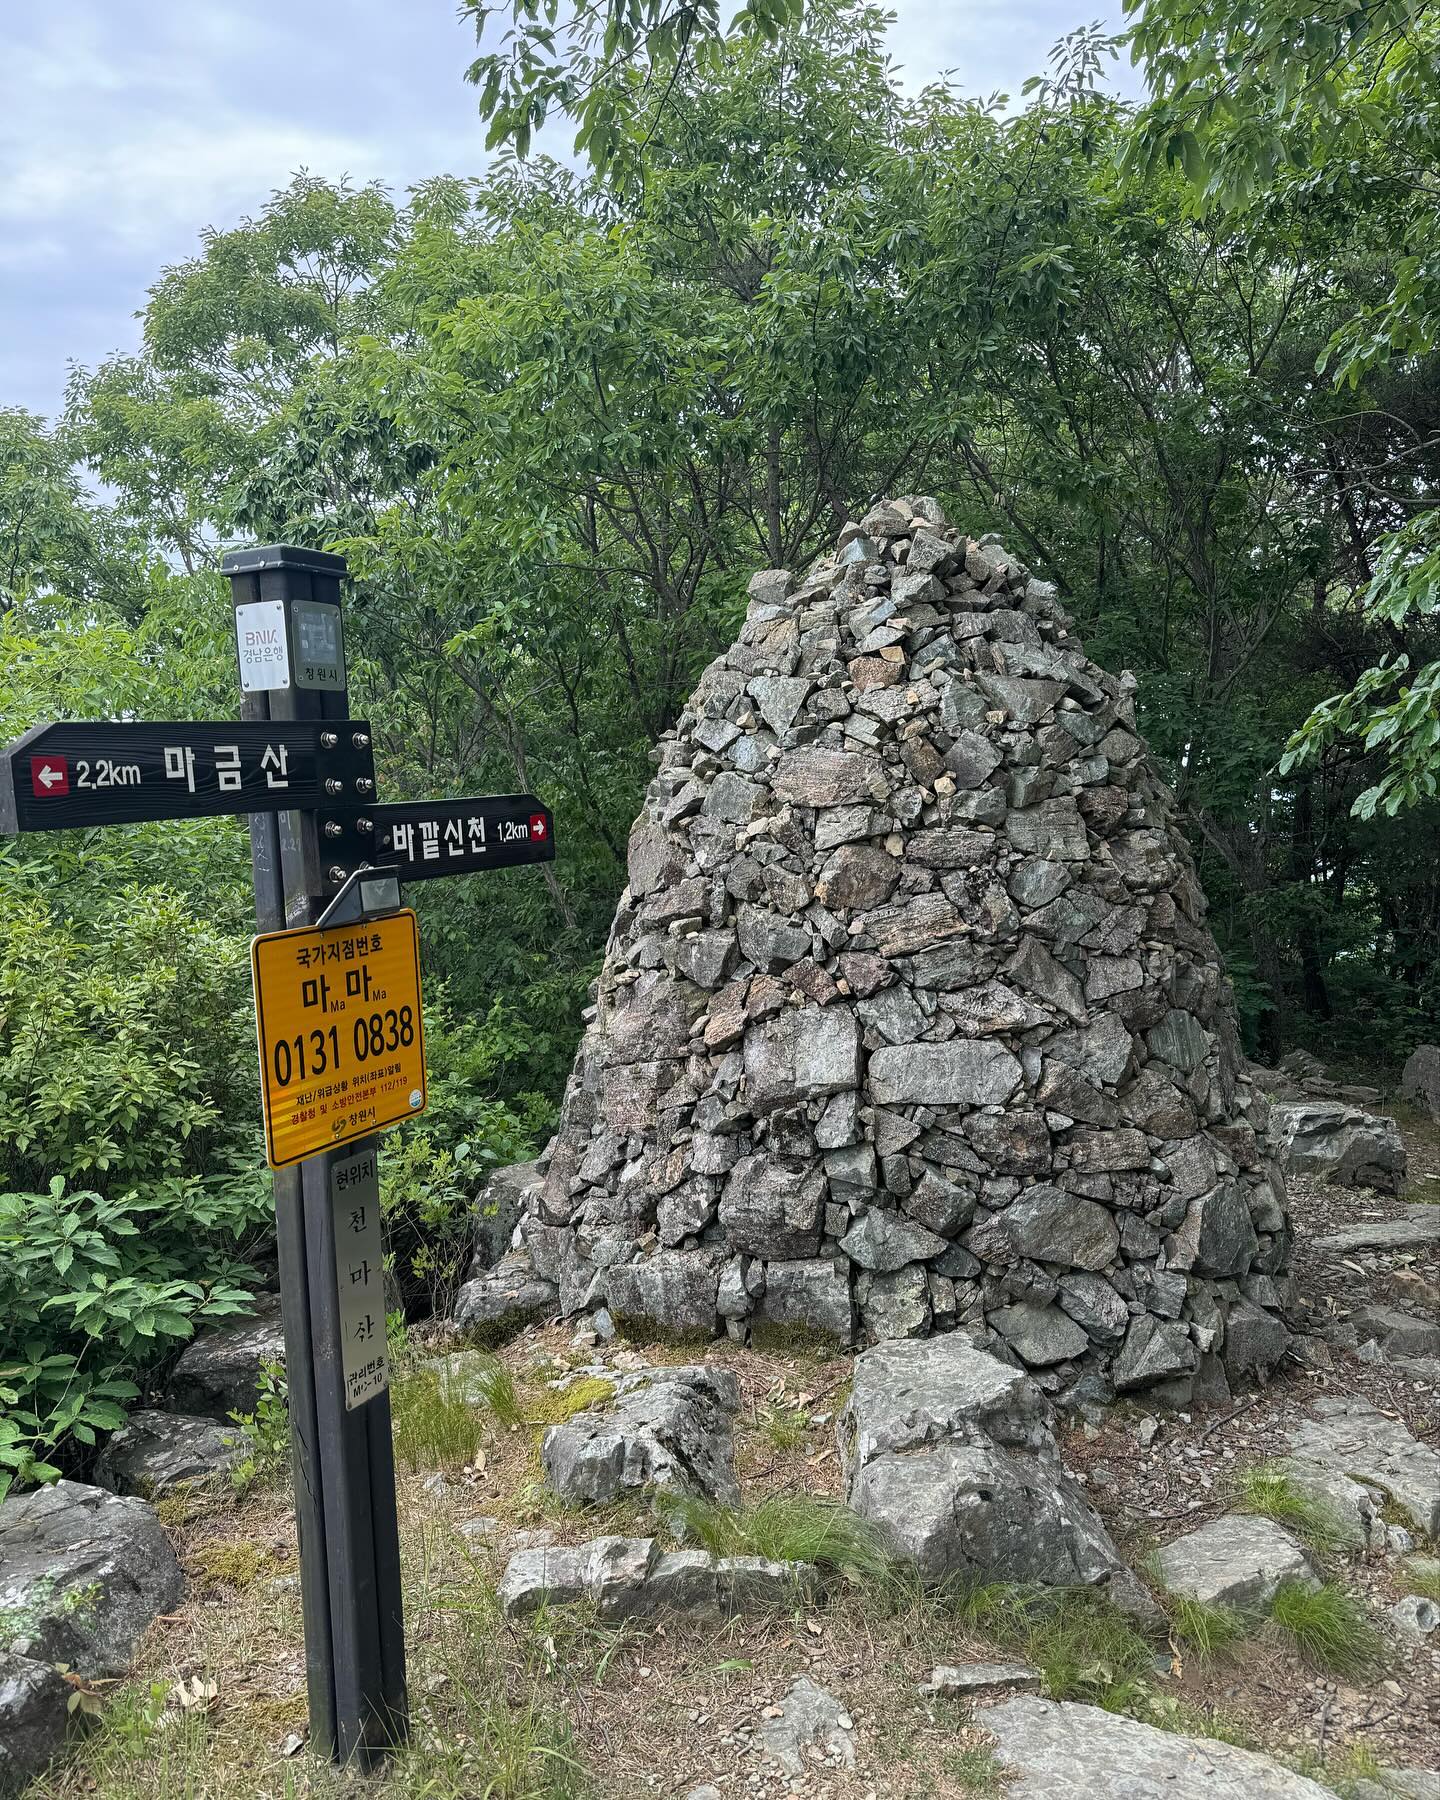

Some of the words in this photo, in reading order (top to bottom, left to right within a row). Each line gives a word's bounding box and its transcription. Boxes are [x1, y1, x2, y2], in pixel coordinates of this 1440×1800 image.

[243, 646, 283, 664] 경남은행
[245, 629, 278, 647] BNK
[305, 667, 338, 681] 창원시
[76, 759, 141, 790] 2.2km
[164, 743, 289, 793] 마금산
[392, 816, 487, 862] 바깥신천
[497, 821, 528, 842] 1.2km
[296, 934, 383, 968] 국가지점번호
[302, 974, 331, 1013] 마
[330, 1000, 346, 1013] Ma
[346, 964, 372, 1002] 마
[372, 989, 387, 1001] Ma
[274, 1024, 340, 1087] 0131
[353, 1005, 414, 1062] 0838
[291, 1108, 316, 1125] 경찰청
[320, 1104, 328, 1114] 및
[331, 1087, 377, 1111] 소방안전본부
[380, 1077, 408, 1093] 112/119
[296, 1081, 348, 1106] 재난/위급상황
[352, 1062, 401, 1088] 위치(좌표)알림
[348, 1106, 376, 1126] 창원시
[336, 1159, 374, 1191] 현위치
